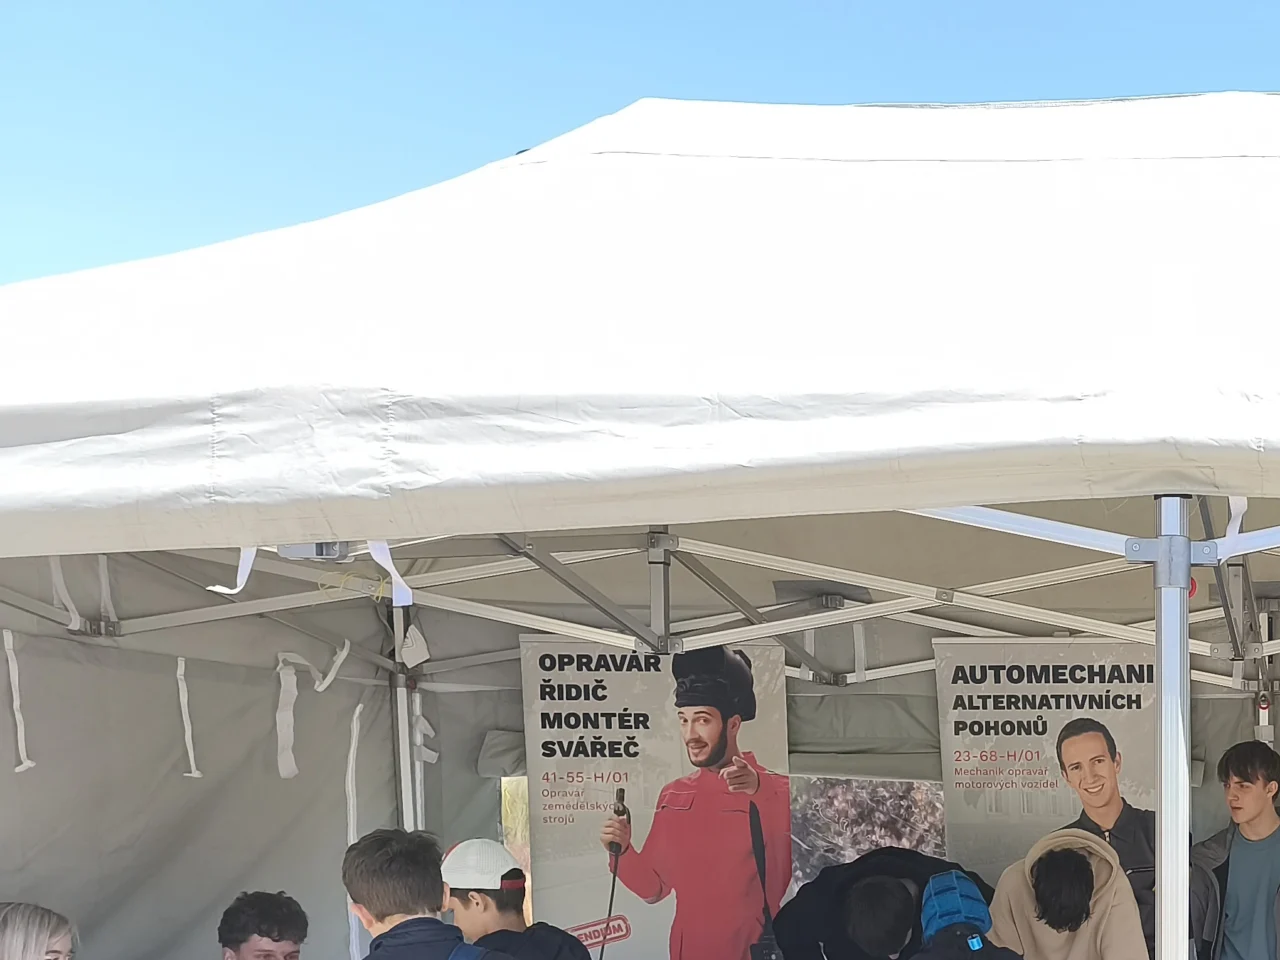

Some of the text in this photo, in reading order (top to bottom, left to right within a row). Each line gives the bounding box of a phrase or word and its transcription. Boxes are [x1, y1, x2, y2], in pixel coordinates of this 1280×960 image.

[951, 664, 1154, 684] AUTOMECHANI
[540, 678, 608, 701] ŘIDIČ
[952, 689, 1142, 710] ALTERNATIVNÍCH
[540, 708, 650, 730] MONTÉR
[953, 715, 1048, 736] POHONŮ
[541, 736, 639, 758] SVÁŘEČ
[954, 750, 1041, 762] 23-68-H/01
[541, 771, 629, 784] 41-55-H/01
[954, 767, 1048, 778] Mechanik opravář
[955, 779, 1059, 790] motorových vozidel
[542, 801, 615, 813] zemědělskýc
[577, 923, 624, 942] ENDIUM
